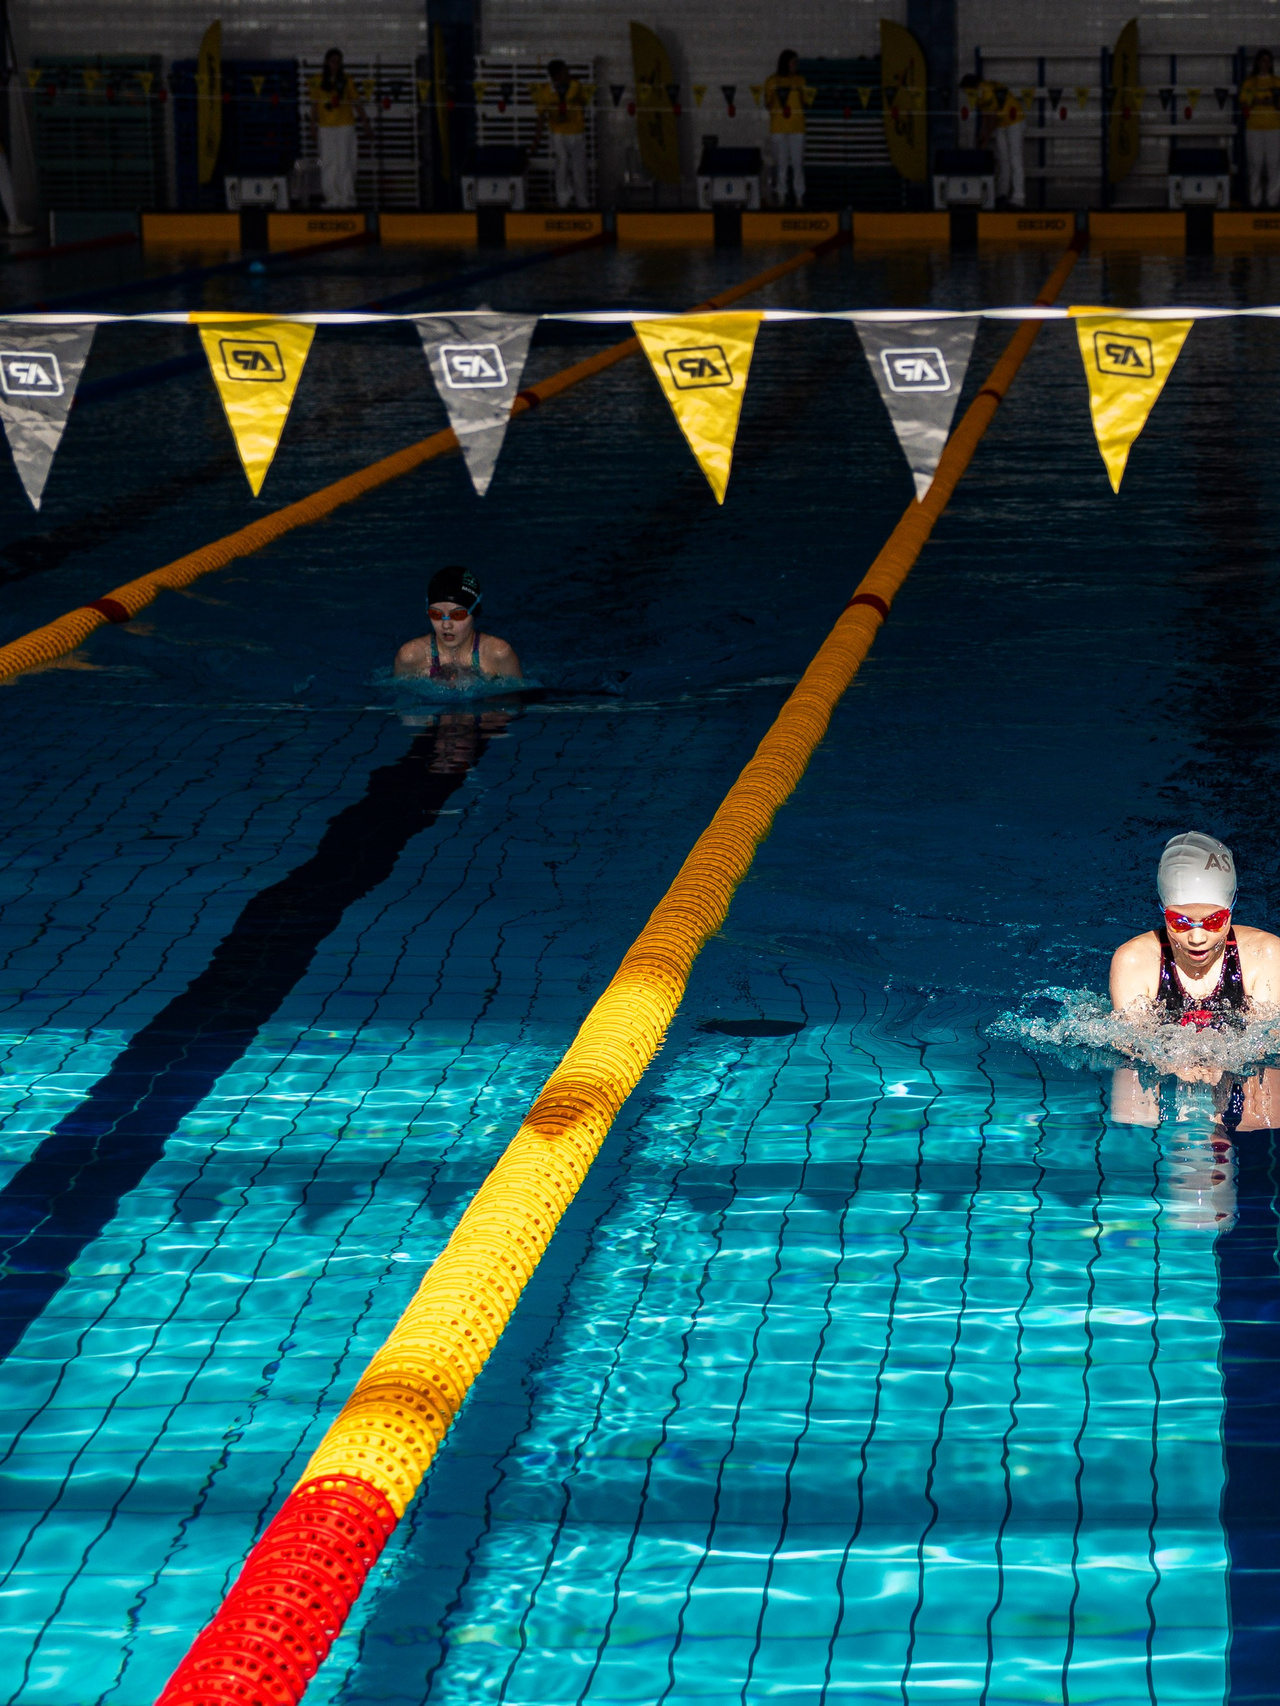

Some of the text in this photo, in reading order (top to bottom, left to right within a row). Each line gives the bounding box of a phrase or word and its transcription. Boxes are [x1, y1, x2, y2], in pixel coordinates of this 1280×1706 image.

[307, 219, 357, 232] SEIKO
[544, 219, 594, 232] SEIKO
[781, 219, 831, 232] SEIKO
[1017, 219, 1067, 231] SEIKO
[1204, 853, 1232, 873] AS
